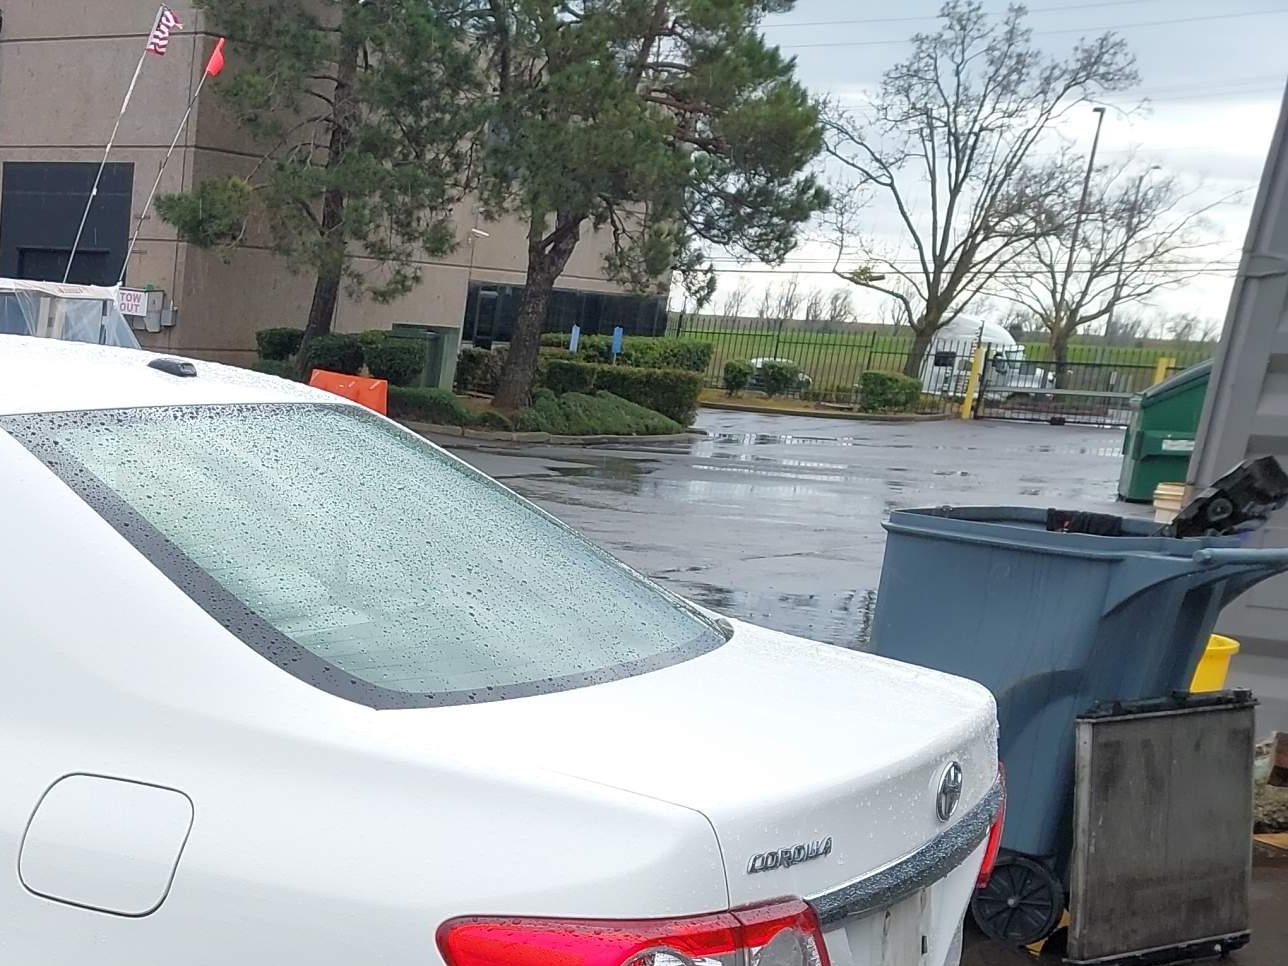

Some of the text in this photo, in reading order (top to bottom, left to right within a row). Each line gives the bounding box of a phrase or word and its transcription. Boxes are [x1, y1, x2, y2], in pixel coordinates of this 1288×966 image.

[120, 292, 142, 303] TOW
[120, 303, 140, 313] OUT
[746, 835, 833, 875] COROLLA
